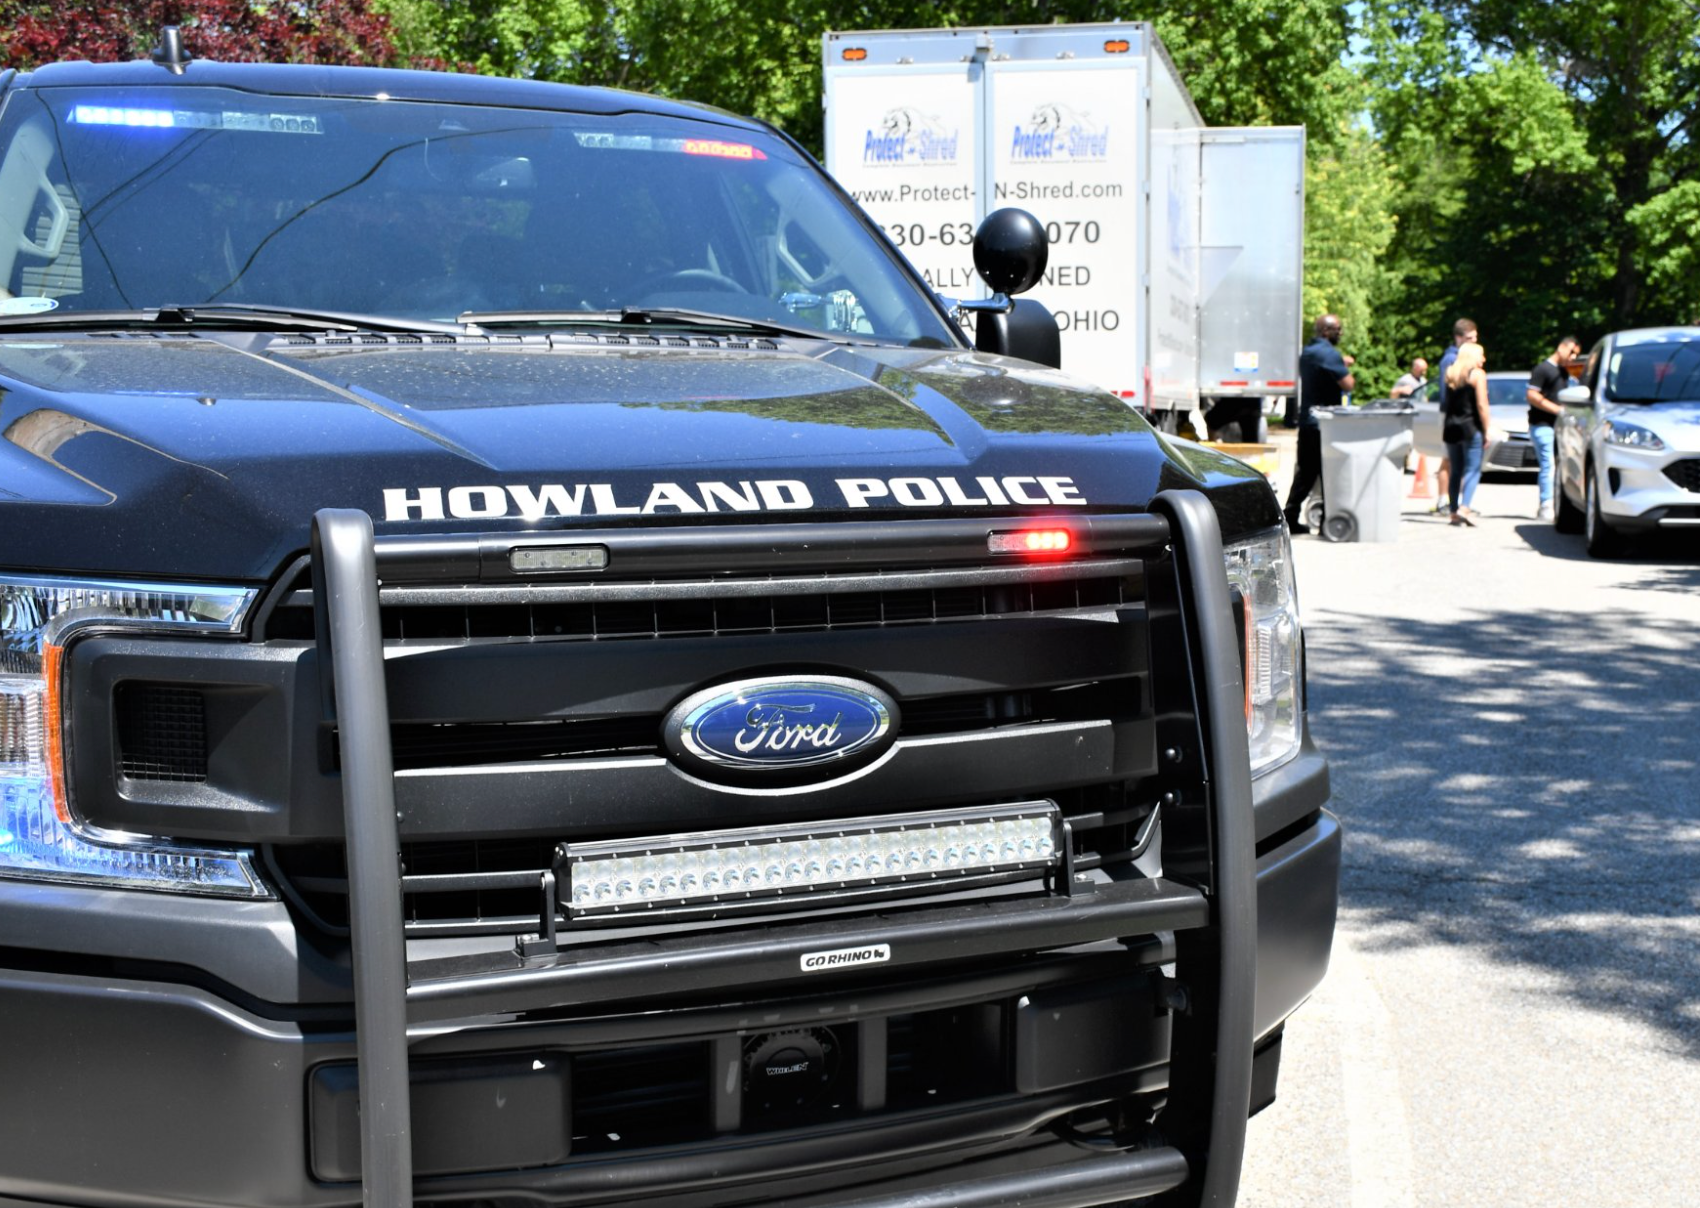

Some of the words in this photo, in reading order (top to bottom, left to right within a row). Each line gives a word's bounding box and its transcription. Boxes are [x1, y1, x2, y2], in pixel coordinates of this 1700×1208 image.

[864, 129, 905, 162] Protect
[919, 128, 958, 160] Shred
[1011, 125, 1055, 158] Protect
[1069, 124, 1109, 157] Shred
[922, 267, 975, 288] ALLY
[1039, 265, 1091, 287] NED
[1053, 309, 1120, 332] OHIO
[382, 479, 815, 521] HOWLAND
[834, 476, 1088, 508] POLICE
[734, 702, 843, 753] Ford
[827, 950, 872, 965] RHINO
